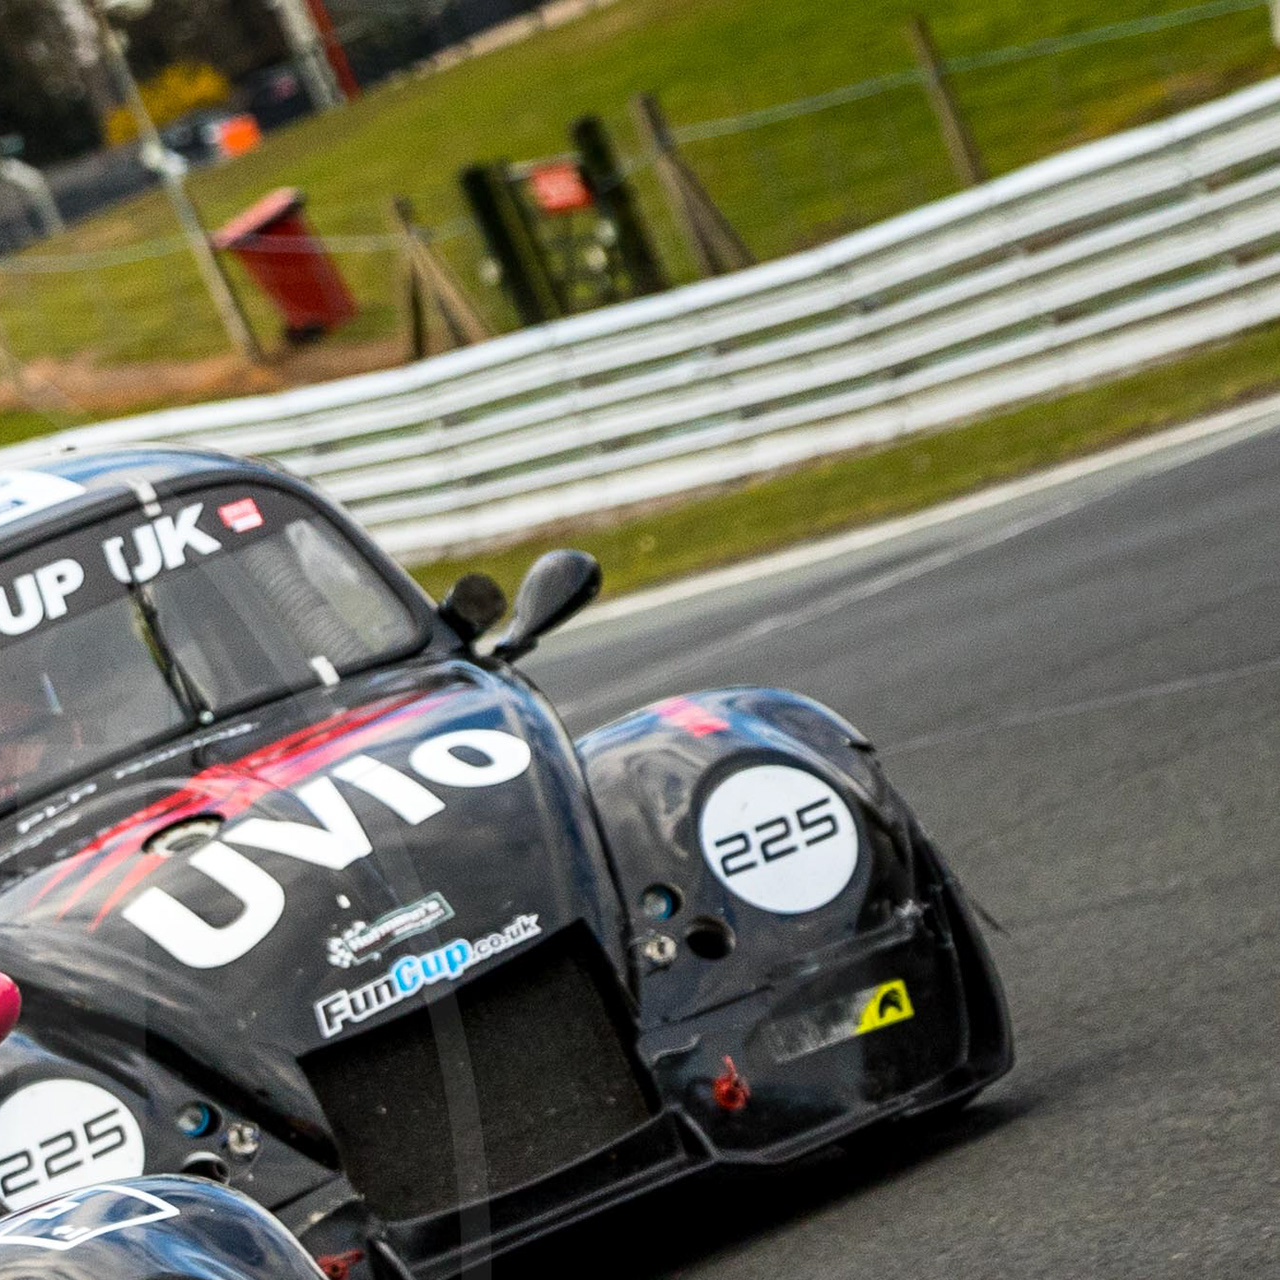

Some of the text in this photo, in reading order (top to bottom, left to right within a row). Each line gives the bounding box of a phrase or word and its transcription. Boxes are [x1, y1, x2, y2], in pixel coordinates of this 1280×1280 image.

[102, 503, 222, 585] UK
[714, 798, 842, 880] 225
[315, 913, 543, 1040] FunCup.co.uk
